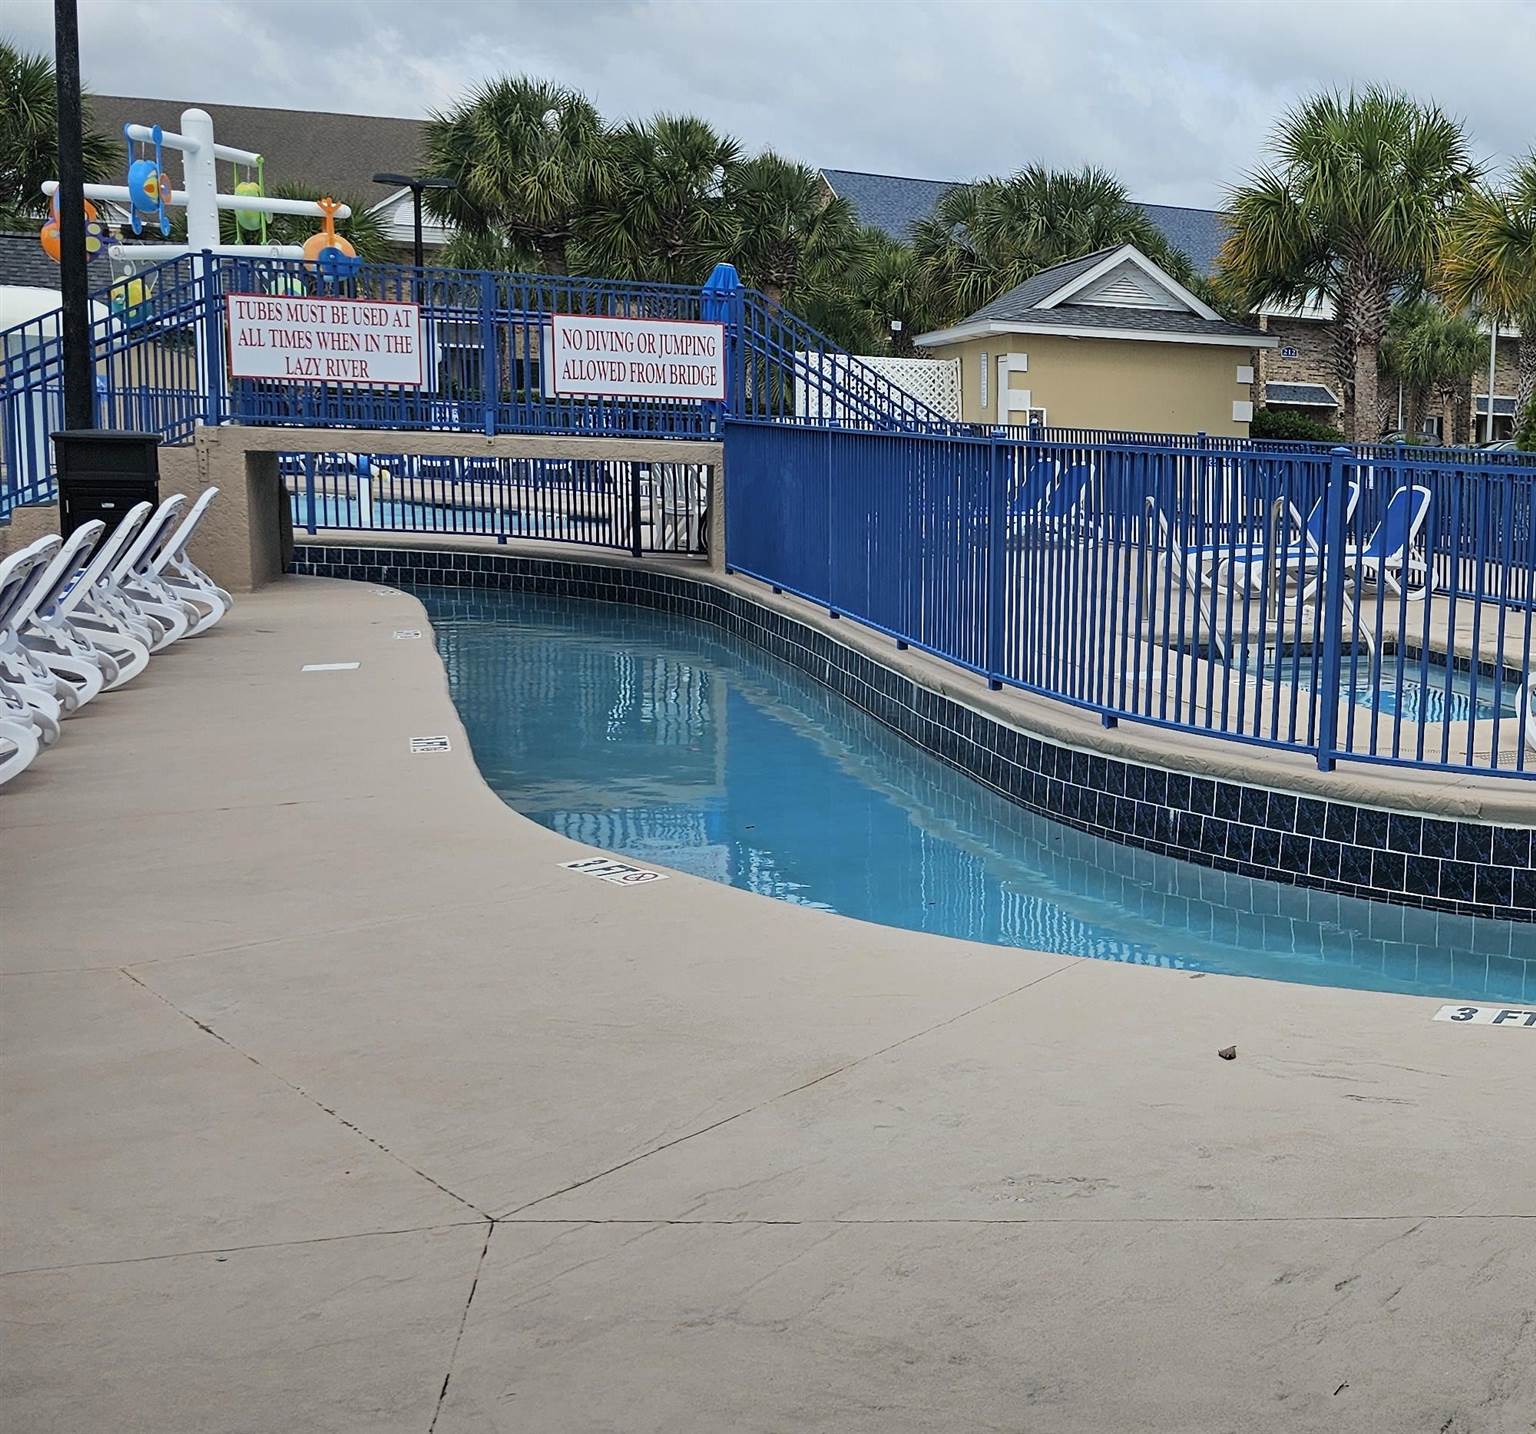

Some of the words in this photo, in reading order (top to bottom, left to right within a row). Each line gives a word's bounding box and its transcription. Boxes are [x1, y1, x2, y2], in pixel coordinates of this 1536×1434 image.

[236, 301, 283, 321] TUBES
[287, 304, 327, 324] MUST
[332, 306, 349, 324] BE
[352, 307, 388, 326] USED
[393, 309, 412, 328] AT
[238, 328, 265, 347] ALL
[269, 329, 313, 349] TIMES
[316, 331, 360, 351] WHEN
[365, 334, 380, 352] IN
[384, 335, 413, 354] THE
[562, 328, 582, 350] NO
[585, 330, 634, 353] DIVING
[637, 332, 656, 354] OR
[658, 334, 716, 358] JUMPING
[284, 356, 321, 376] LAZY
[327, 359, 370, 378] RIVER
[562, 359, 626, 382] ALLOWED
[630, 362, 666, 384] FROM
[670, 364, 717, 386] BRIDGE
[1450, 1007, 1478, 1022] 3
